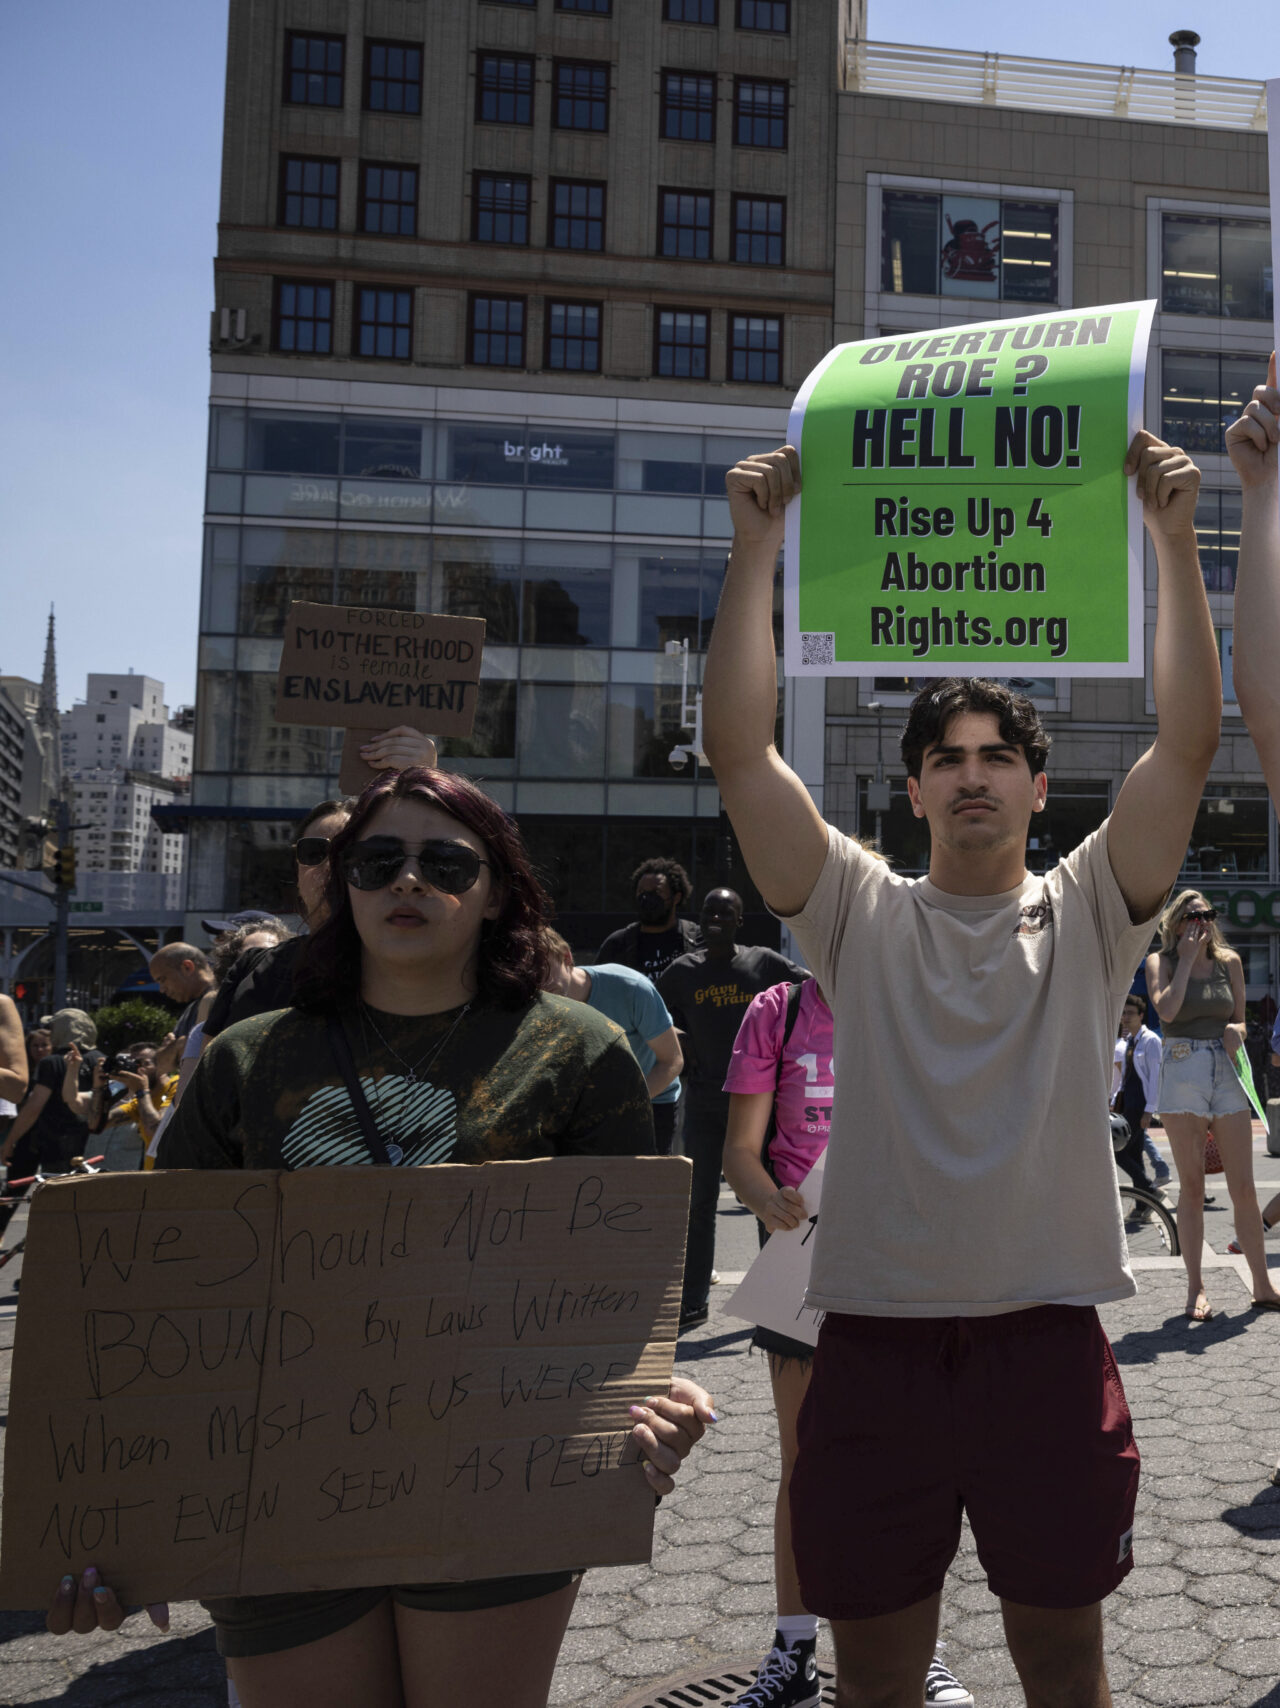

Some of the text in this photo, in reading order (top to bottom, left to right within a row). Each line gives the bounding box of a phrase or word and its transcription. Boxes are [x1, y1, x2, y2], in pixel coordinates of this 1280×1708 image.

[858, 316, 1113, 365] OVERTURN
[896, 355, 1049, 399] ROE ?
[504, 440, 563, 461] brght
[852, 405, 1082, 469] HELL NO!
[874, 496, 1053, 547] Rise Up 4
[880, 551, 1046, 592] Abortion
[347, 609, 425, 630] FORCED
[870, 605, 1069, 657] Rights.org
[296, 626, 475, 663] MOTHERHOOD
[331, 655, 433, 680] is female
[282, 675, 481, 713] ENSLAVEMENT
[695, 984, 737, 1005] Gravy
[712, 992, 754, 1007] Train
[73, 1175, 652, 1288] We Should Not Be
[84, 1278, 640, 1400] BOUND By Laws Written
[49, 1413, 170, 1482] When
[350, 1383, 407, 1435] OF
[427, 1373, 473, 1421] US
[501, 1362, 631, 1409] WERE
[39, 1429, 647, 1559] NOT EVEN SEEN AS PEOPL
